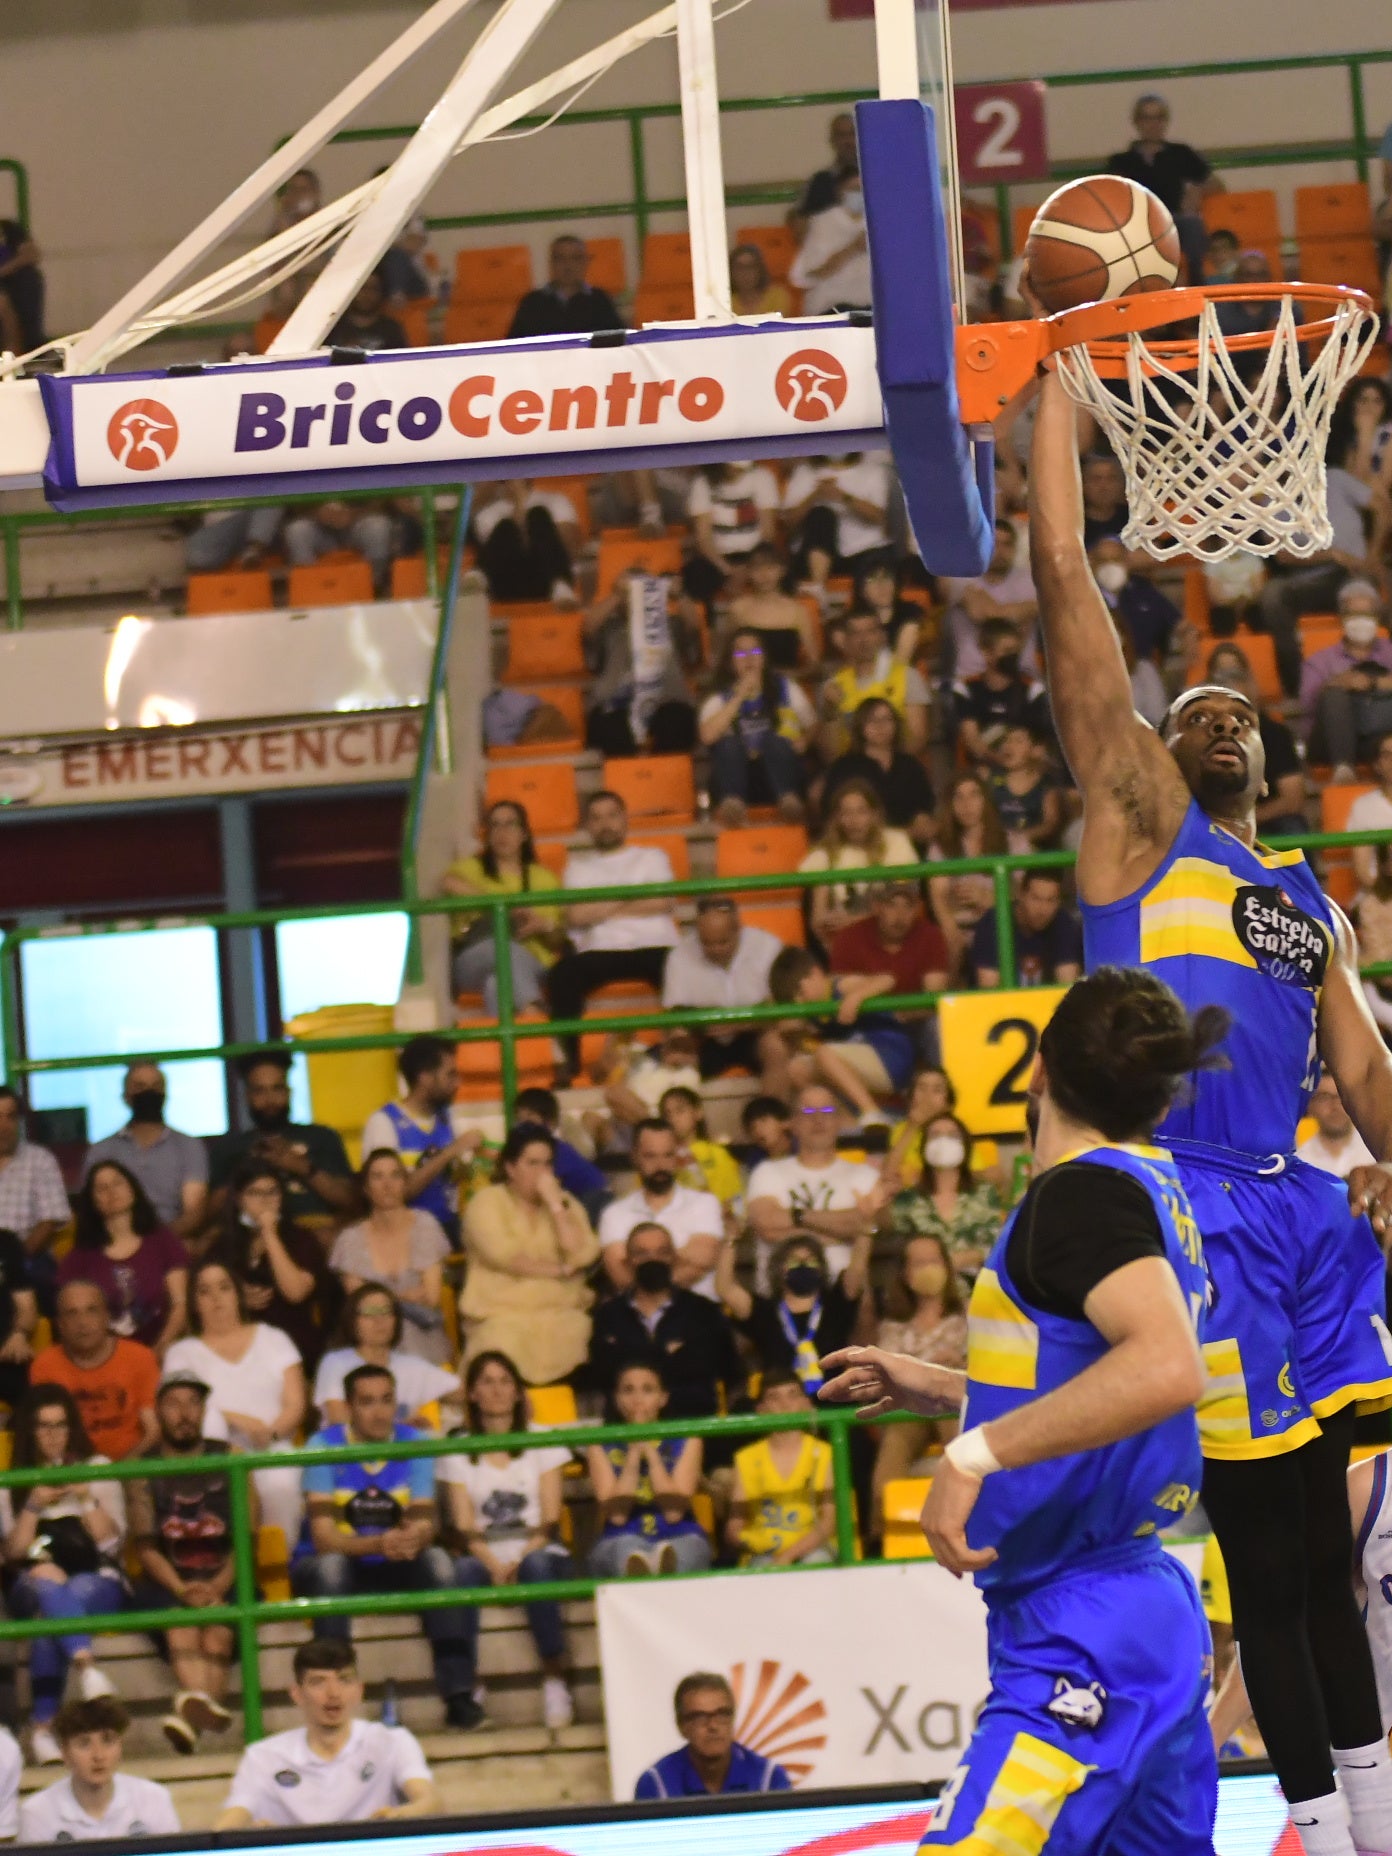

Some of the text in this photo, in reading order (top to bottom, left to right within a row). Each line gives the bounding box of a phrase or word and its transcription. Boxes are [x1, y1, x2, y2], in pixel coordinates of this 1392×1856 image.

[974, 99, 1024, 168] 2
[234, 371, 725, 453] BricoCentro
[62, 715, 423, 788] EMERXENCIA
